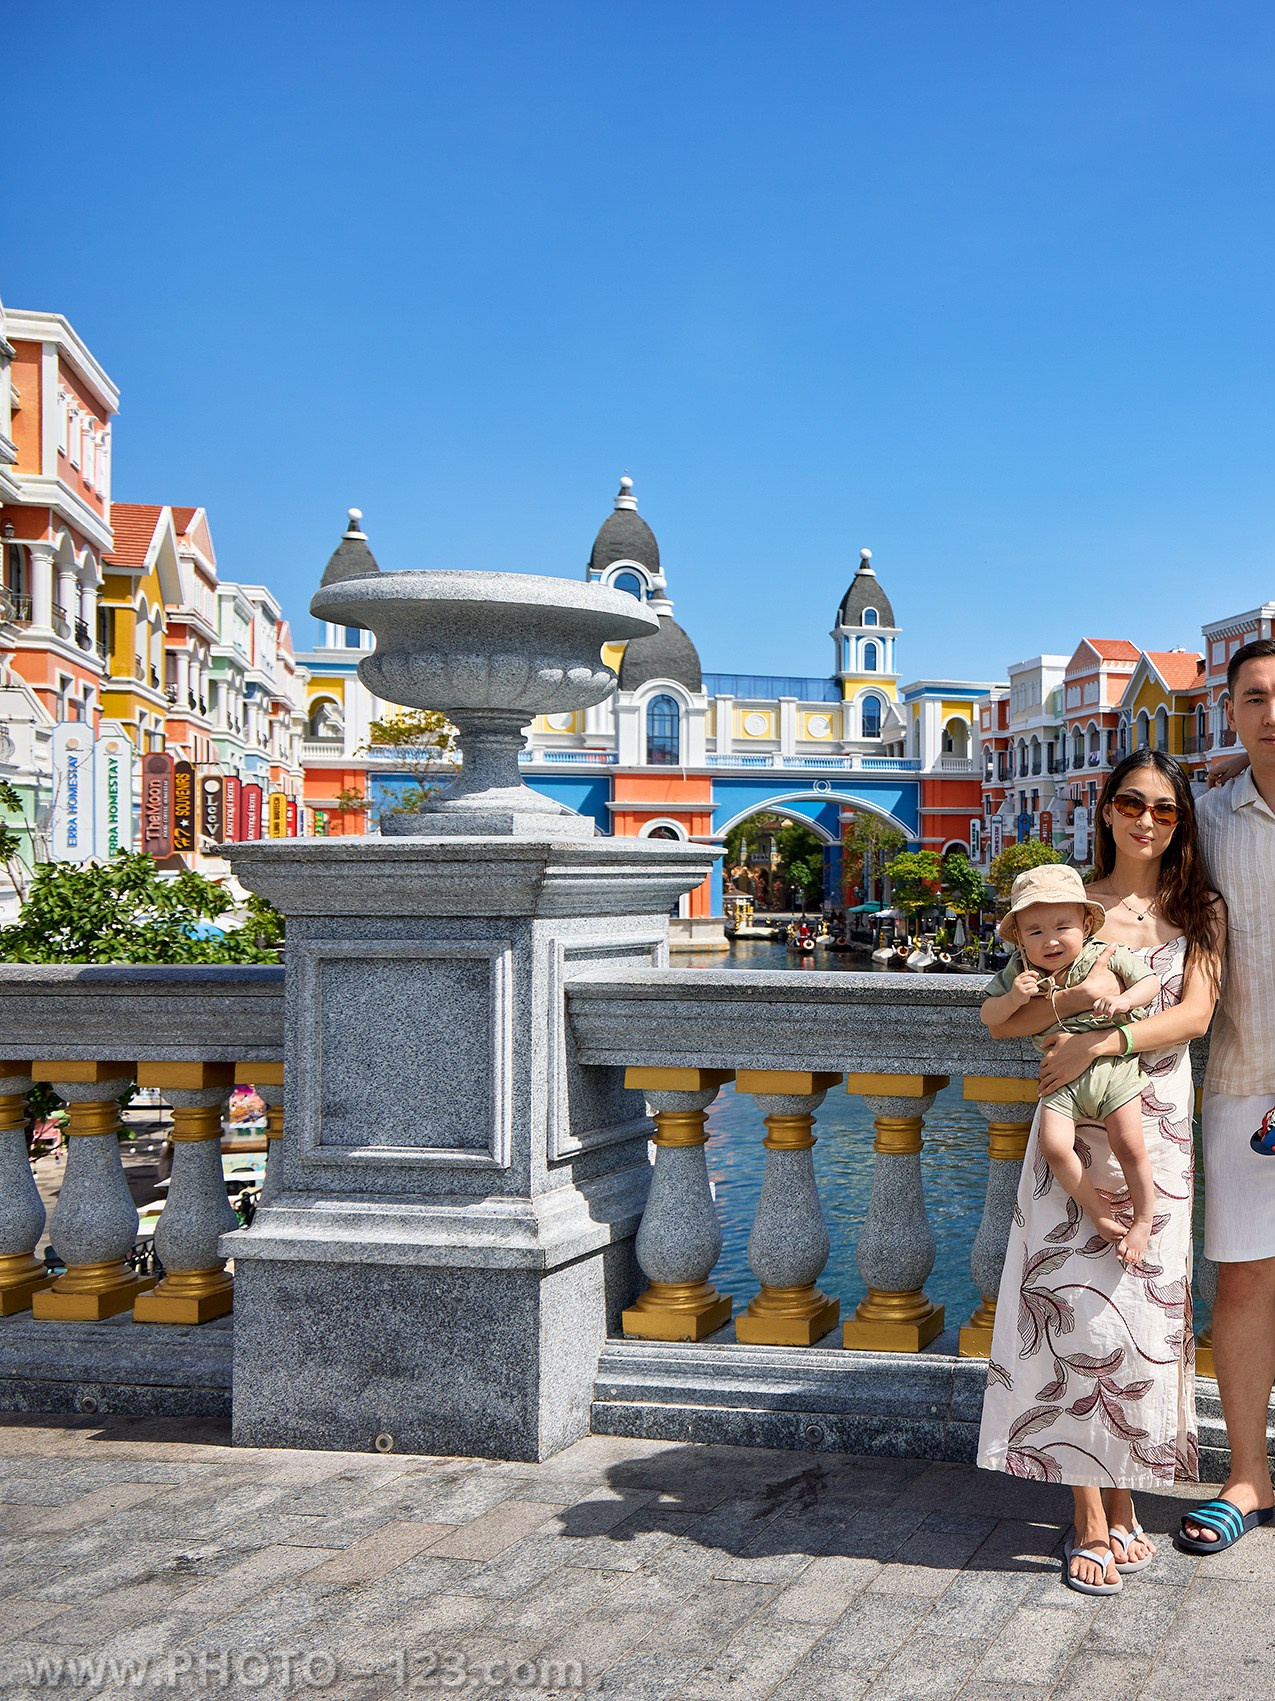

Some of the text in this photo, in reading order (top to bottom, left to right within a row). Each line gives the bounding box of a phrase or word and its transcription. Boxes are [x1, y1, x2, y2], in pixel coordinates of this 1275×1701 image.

[108, 757, 119, 824] HOMESTAY
[145, 779, 161, 841] TheMoon
[66, 817, 78, 848] ERRA
